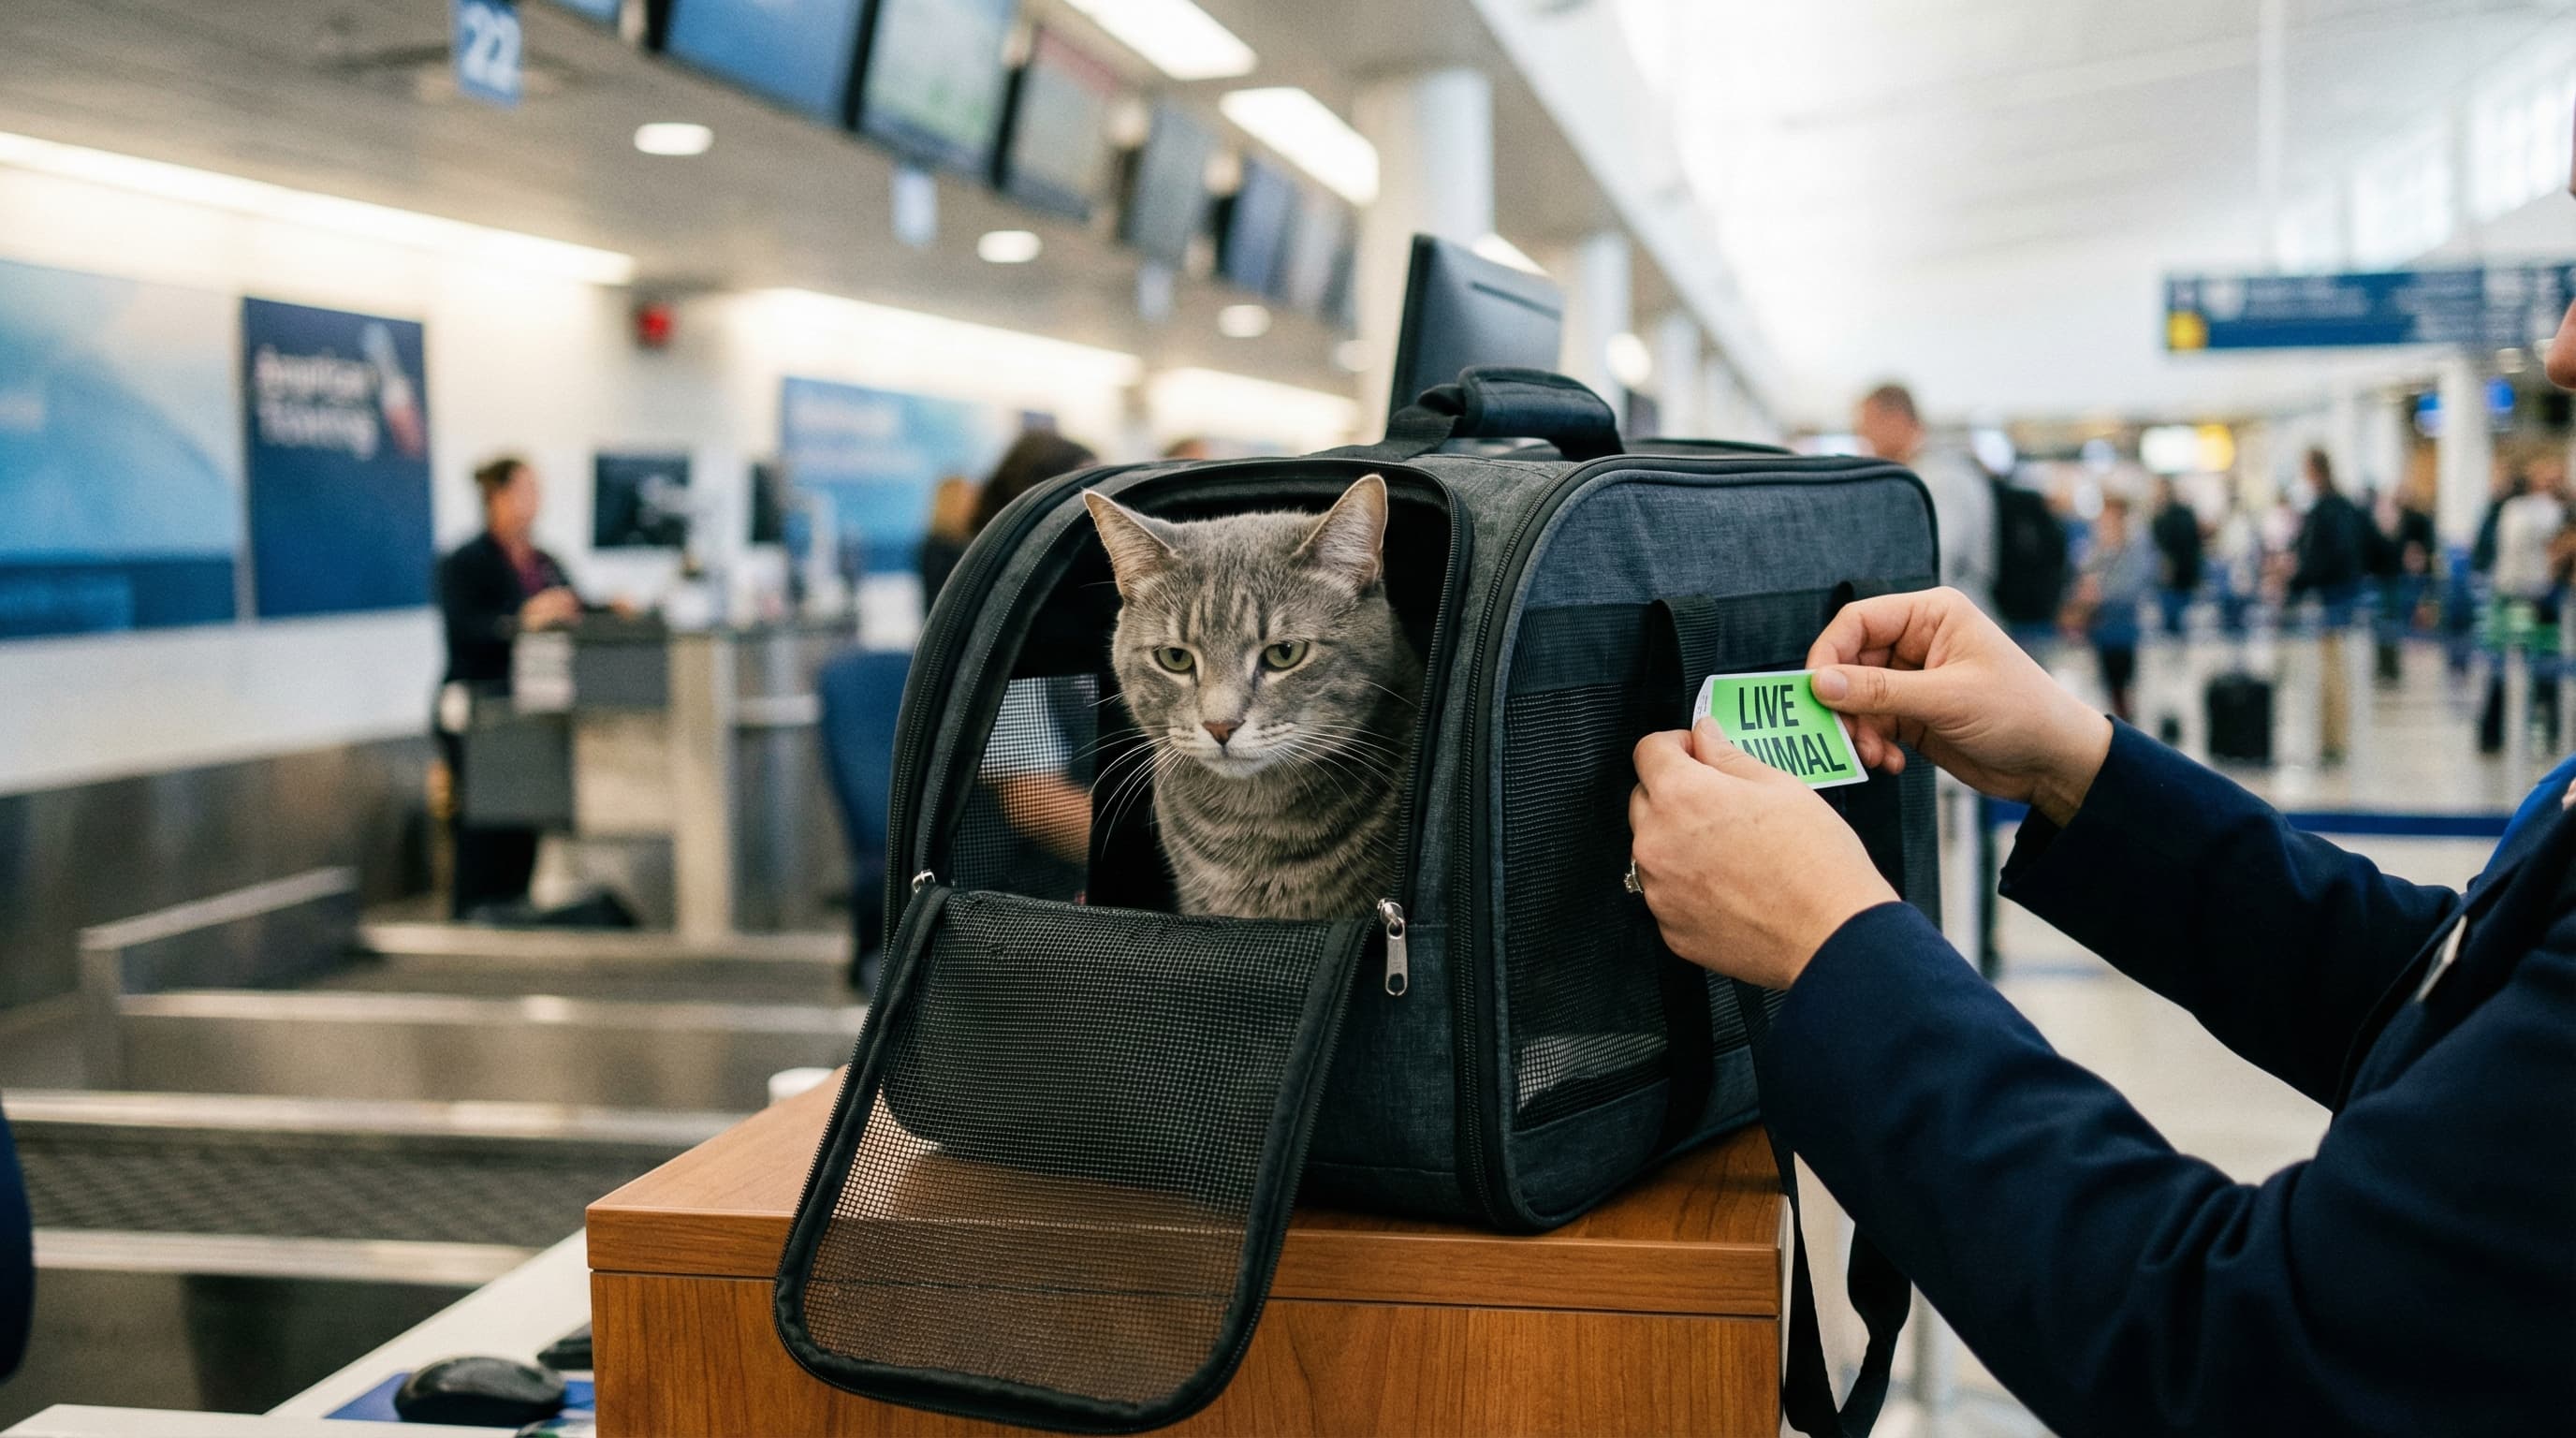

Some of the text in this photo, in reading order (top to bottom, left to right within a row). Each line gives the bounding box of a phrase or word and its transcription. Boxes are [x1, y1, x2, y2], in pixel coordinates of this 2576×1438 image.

[461, 5, 520, 90] 22
[1738, 683, 1799, 730] LIVE
[1730, 733, 1847, 776] NIMAL
